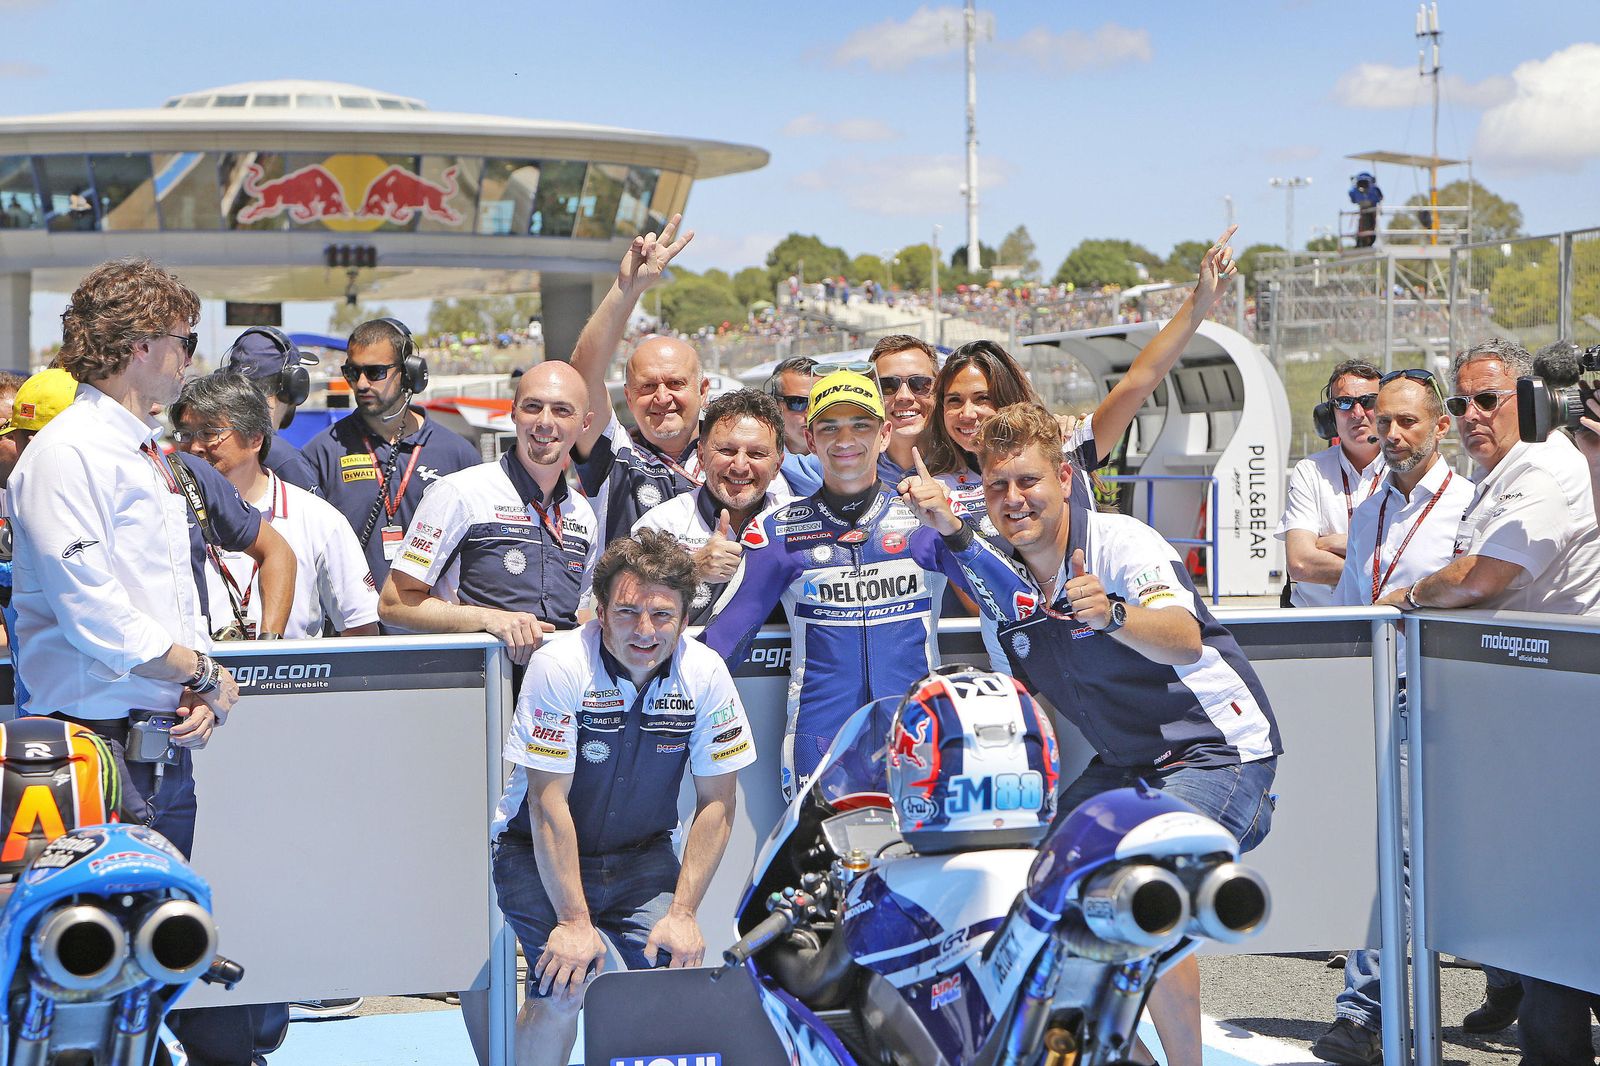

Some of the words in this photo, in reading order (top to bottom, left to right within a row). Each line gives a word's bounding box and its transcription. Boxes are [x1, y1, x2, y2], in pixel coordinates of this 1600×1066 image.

[814, 384, 874, 405] DUNLOP
[185, 483, 204, 509] NPS
[1248, 445, 1267, 559] PULL&BEAR
[562, 520, 588, 535] ELCONCA
[787, 533, 832, 542] BARRACUDA
[840, 568, 879, 579] TEAM
[818, 574, 918, 603] DELCONCA
[1481, 631, 1549, 657] motogp.com
[260, 681, 292, 690] official
[294, 680, 329, 689] website
[655, 699, 695, 711] DELCONC
[533, 746, 567, 756] DUNLOP
[719, 742, 747, 758] DUNLOP
